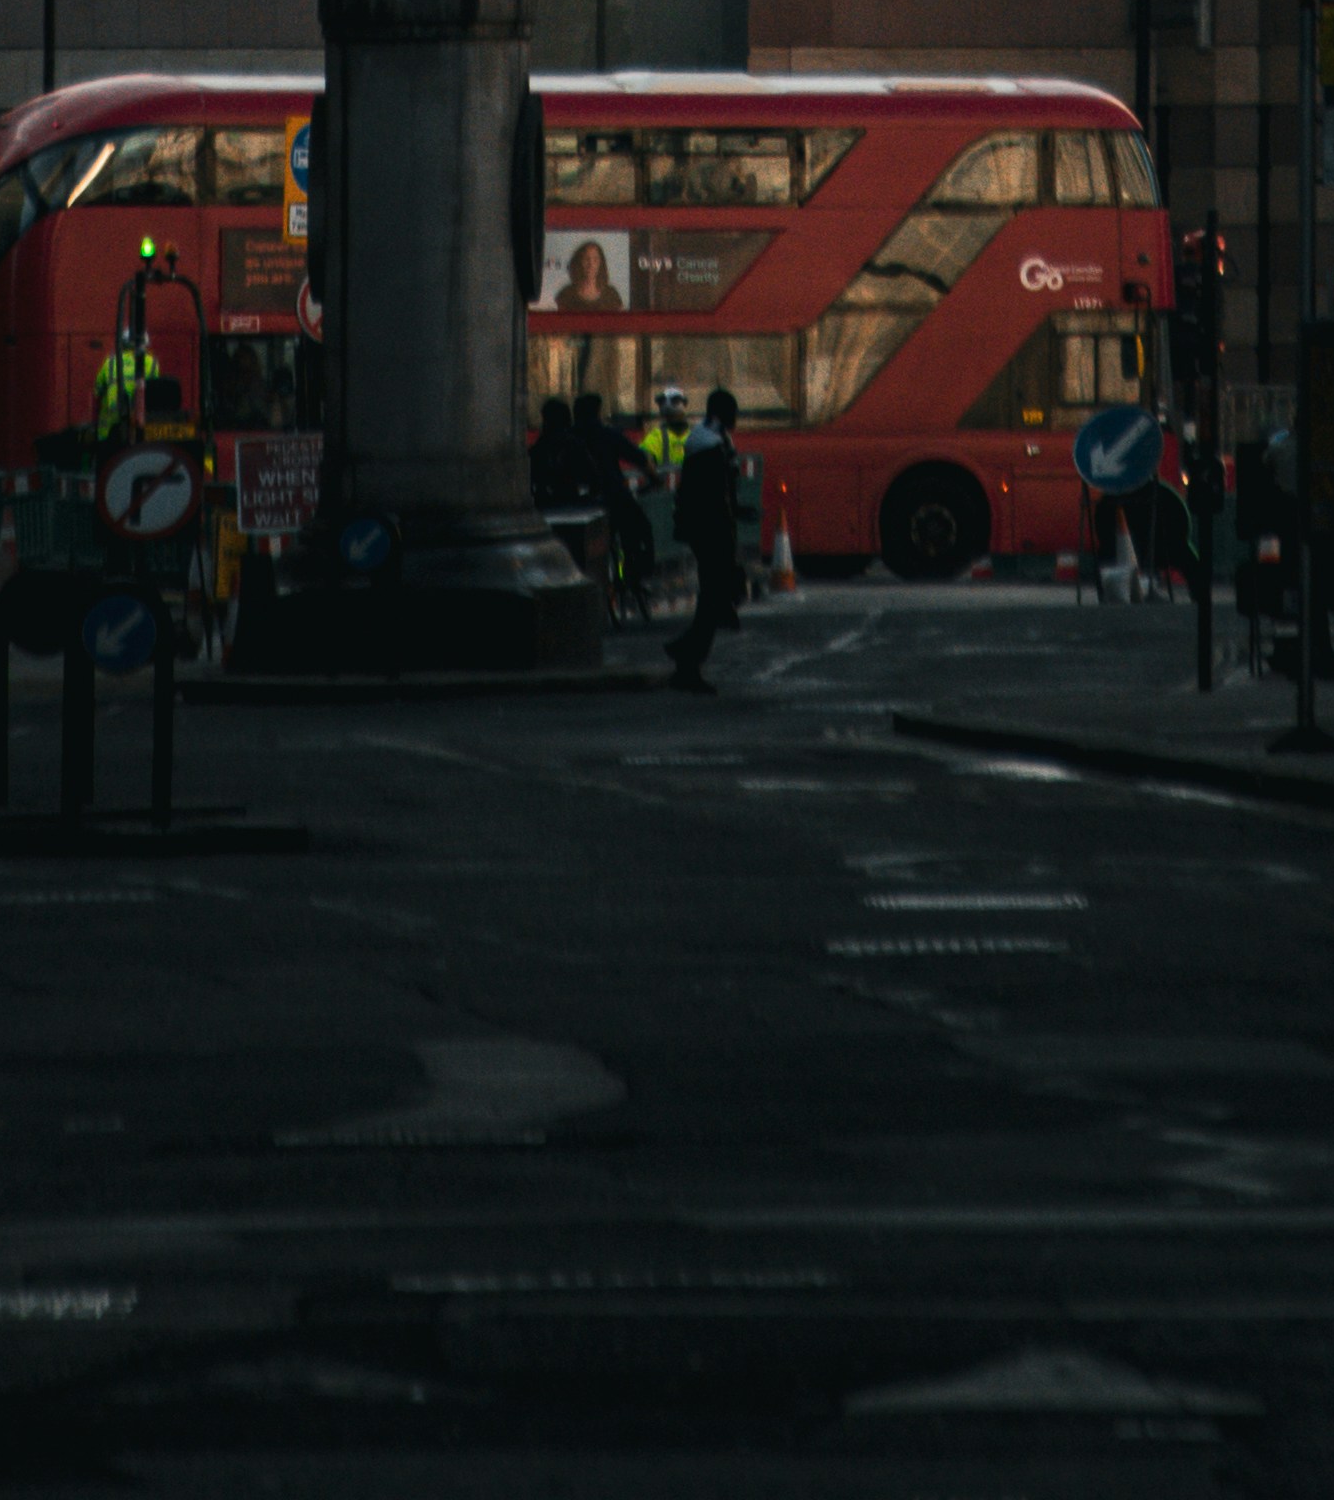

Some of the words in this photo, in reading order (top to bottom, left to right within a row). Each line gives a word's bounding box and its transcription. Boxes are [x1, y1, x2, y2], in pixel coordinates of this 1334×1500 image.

[258, 468, 316, 487] WHEN
[243, 489, 295, 508] LIGHT
[254, 509, 300, 528] WAIT
